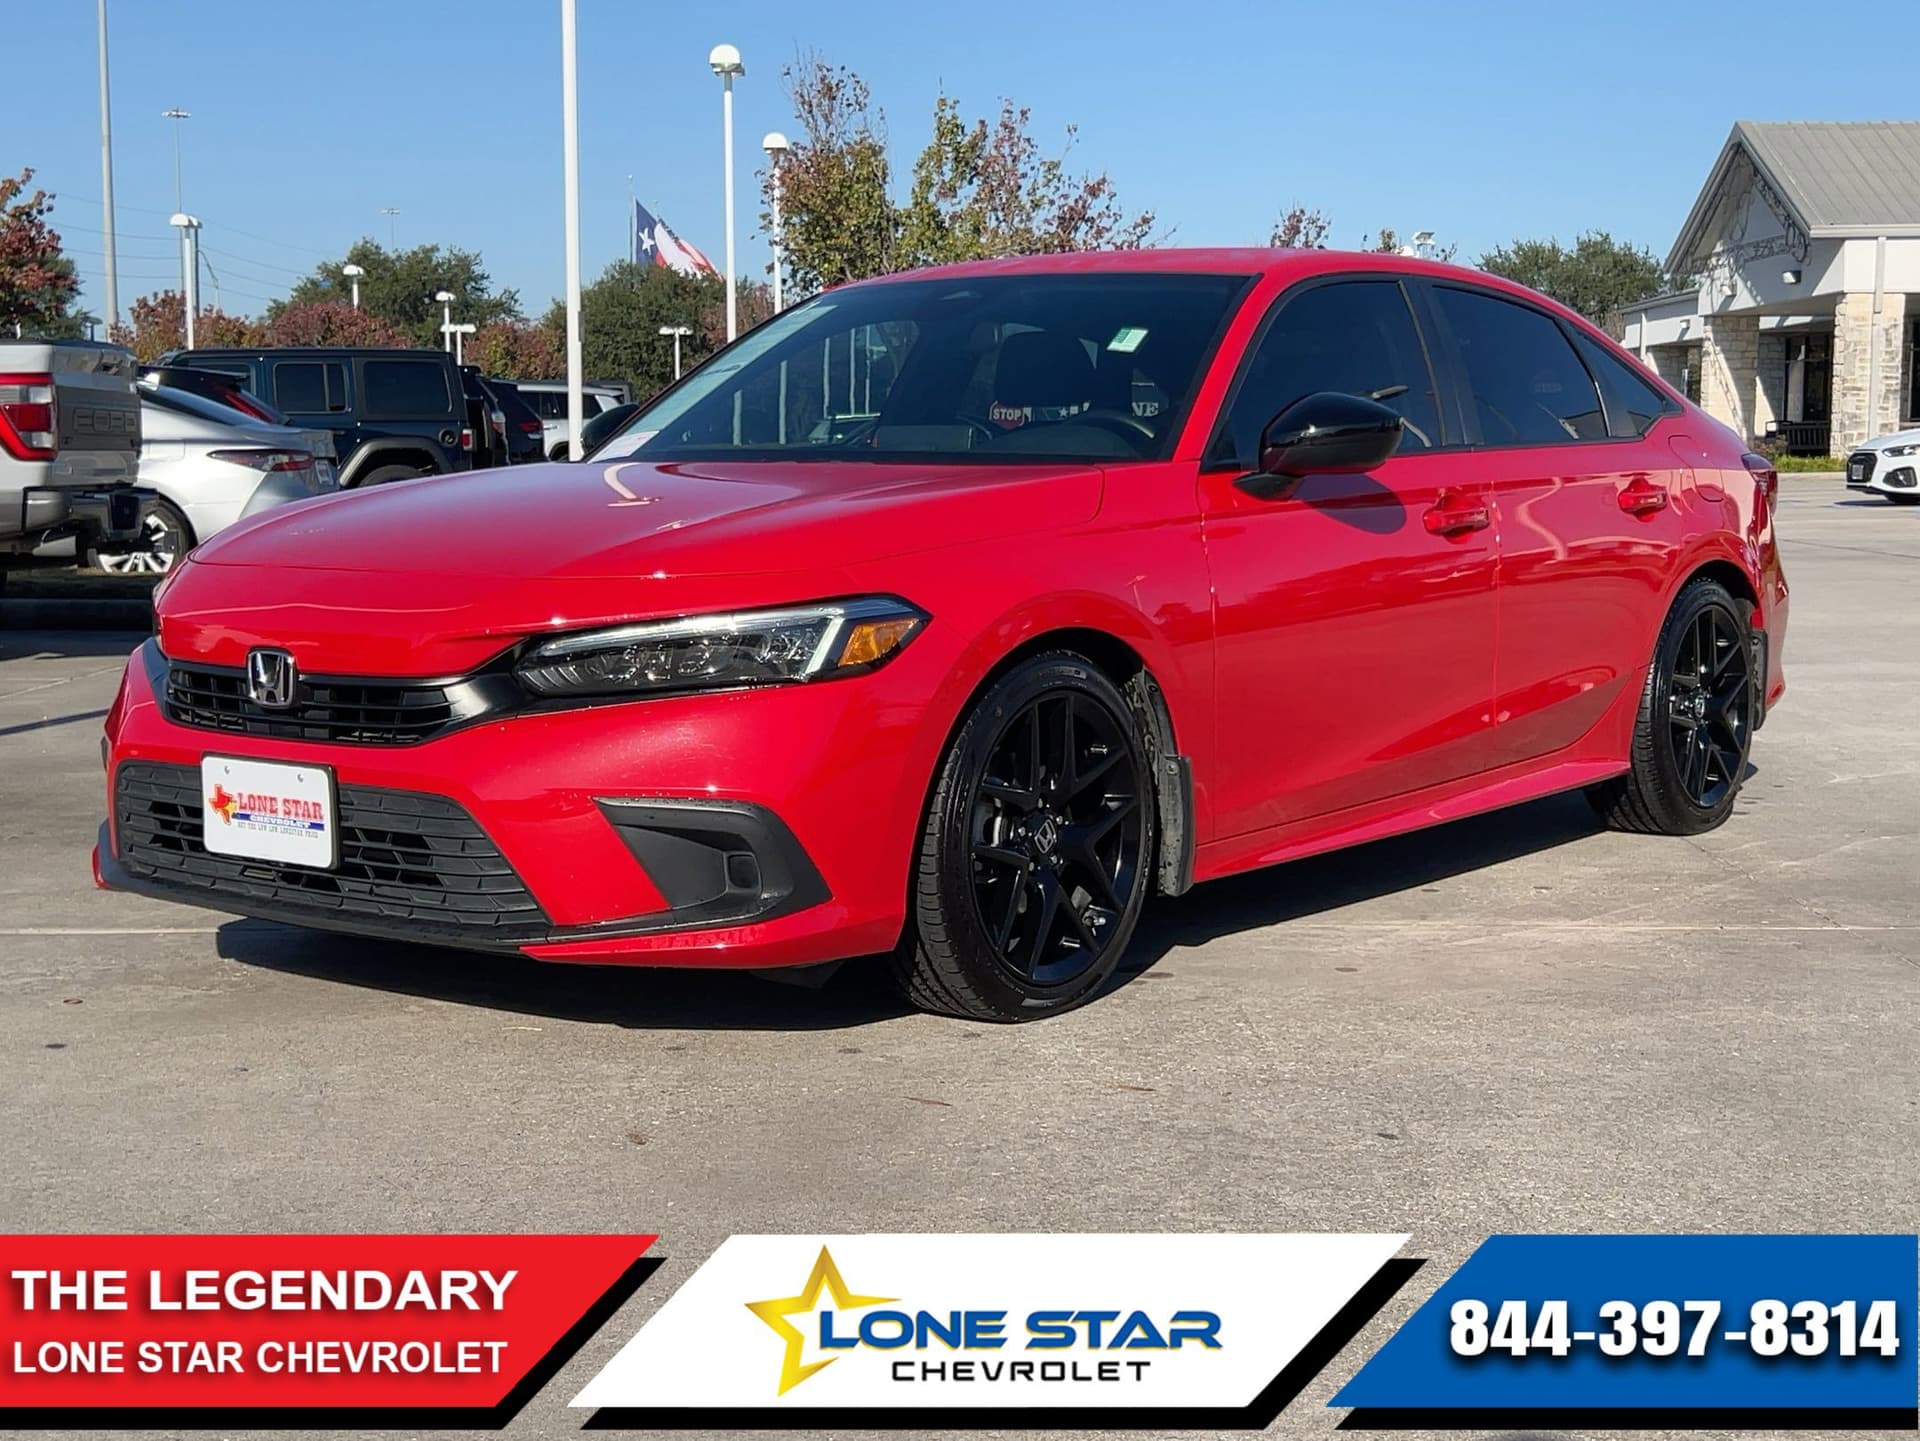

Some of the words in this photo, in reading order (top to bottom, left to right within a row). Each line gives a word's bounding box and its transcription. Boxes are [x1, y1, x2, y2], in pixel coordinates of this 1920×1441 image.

[73, 408, 138, 433] FORD
[993, 408, 1021, 421] STOP
[238, 793, 278, 814] LONE
[283, 798, 323, 820] STAR
[249, 815, 311, 829] CHEVROLET
